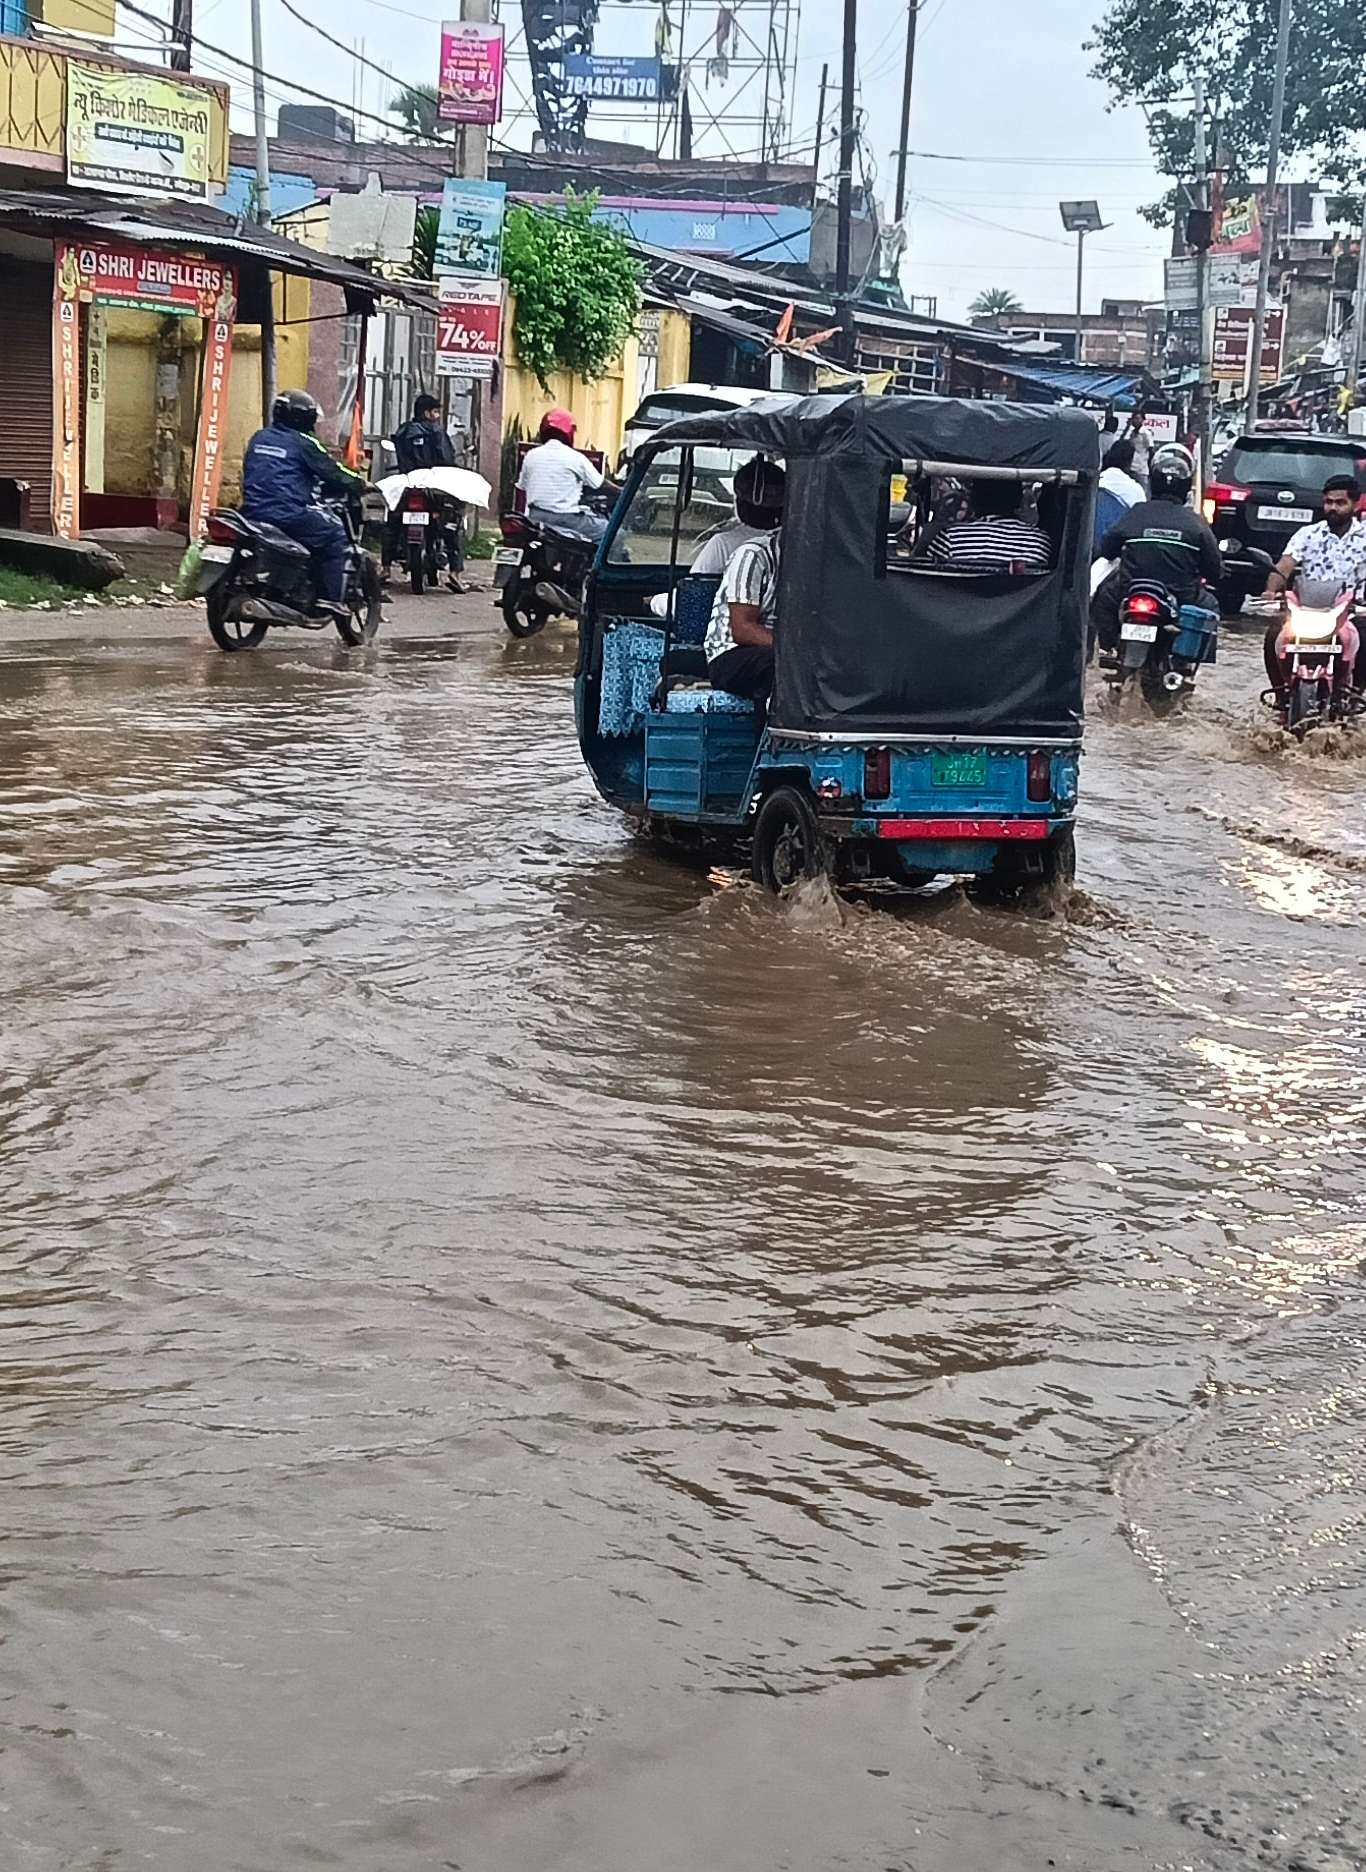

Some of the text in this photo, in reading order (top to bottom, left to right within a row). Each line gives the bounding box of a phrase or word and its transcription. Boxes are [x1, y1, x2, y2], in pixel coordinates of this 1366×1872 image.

[566, 76, 656, 97] 7644971970
[128, 97, 170, 127] मेडिकल
[98, 253, 134, 279] SHRI
[137, 259, 221, 292] JEWELLERS
[439, 322, 496, 352] 74% OFF
